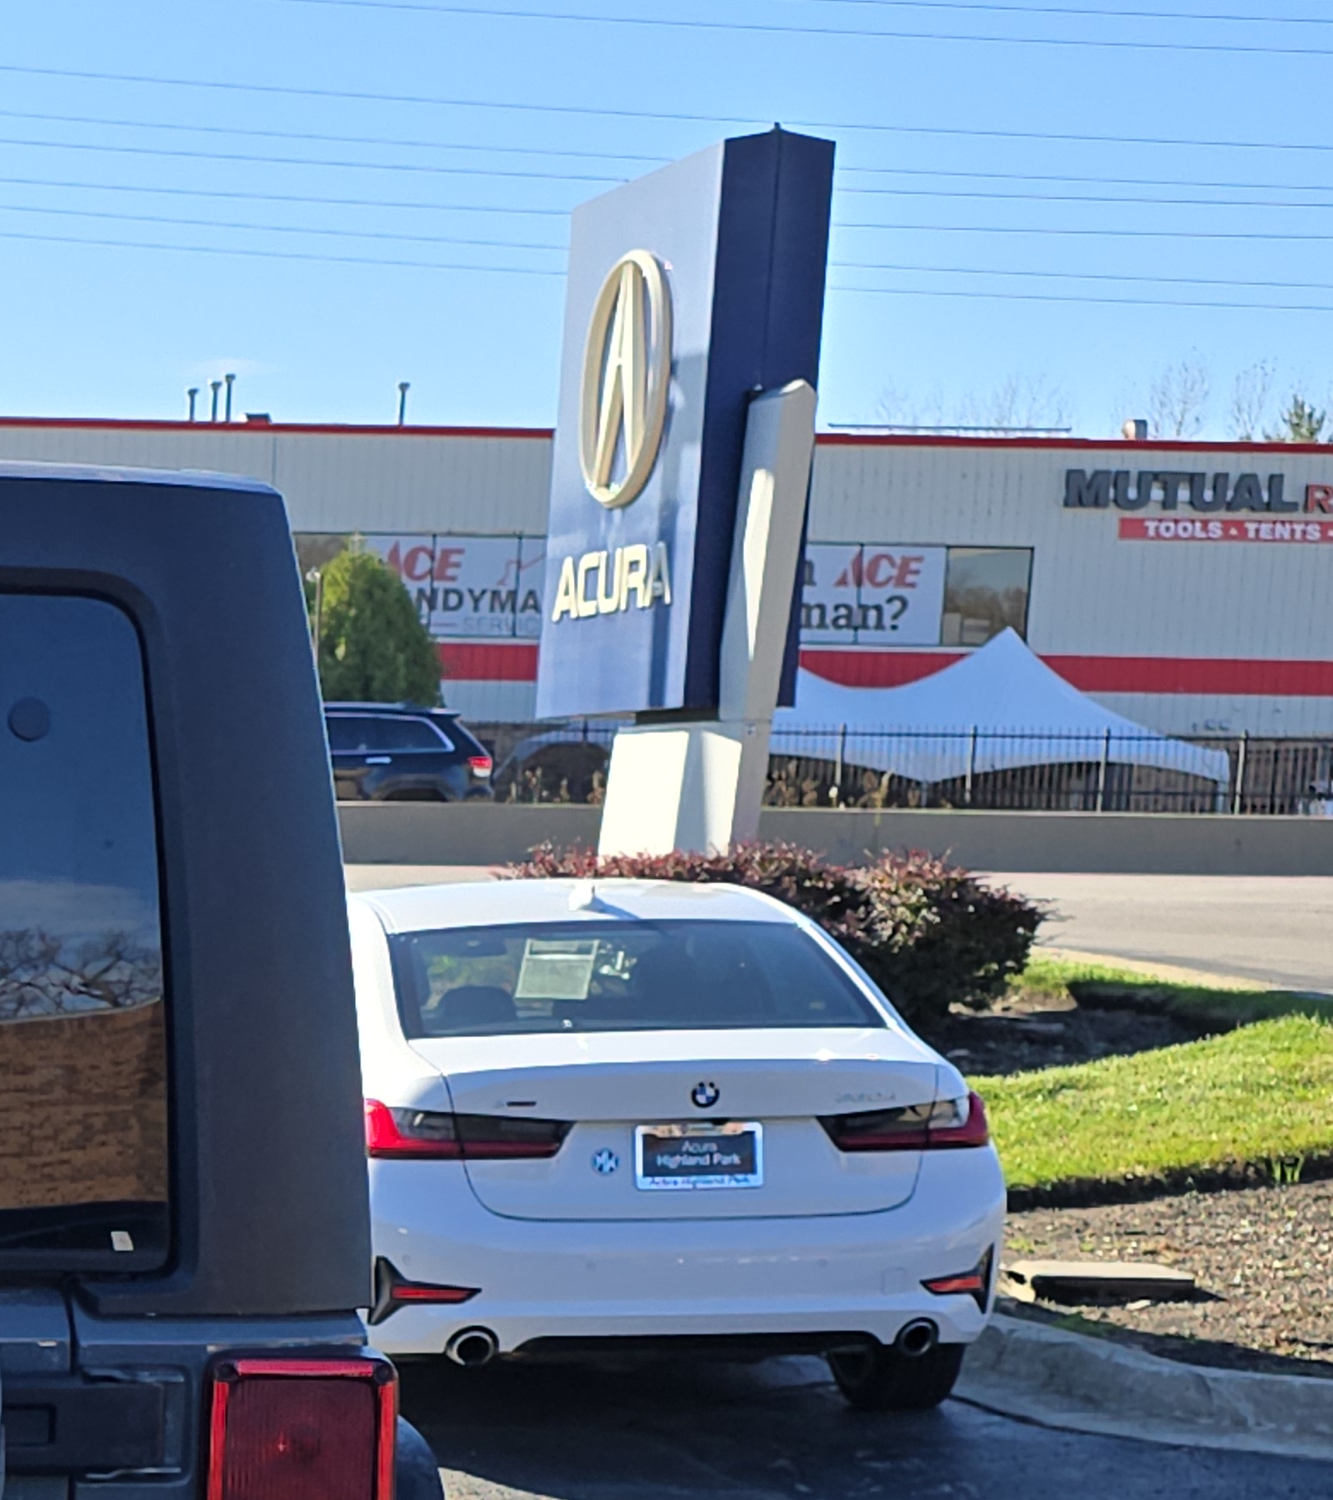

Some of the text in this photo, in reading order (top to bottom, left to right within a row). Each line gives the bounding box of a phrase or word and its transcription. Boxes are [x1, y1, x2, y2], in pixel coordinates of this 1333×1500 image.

[1064, 469, 1333, 514] MUTUAL R
[1143, 519, 1321, 541] TOOLS TENTS
[387, 540, 465, 582] ACE
[551, 541, 671, 622] ACURA
[833, 549, 925, 589] ACE
